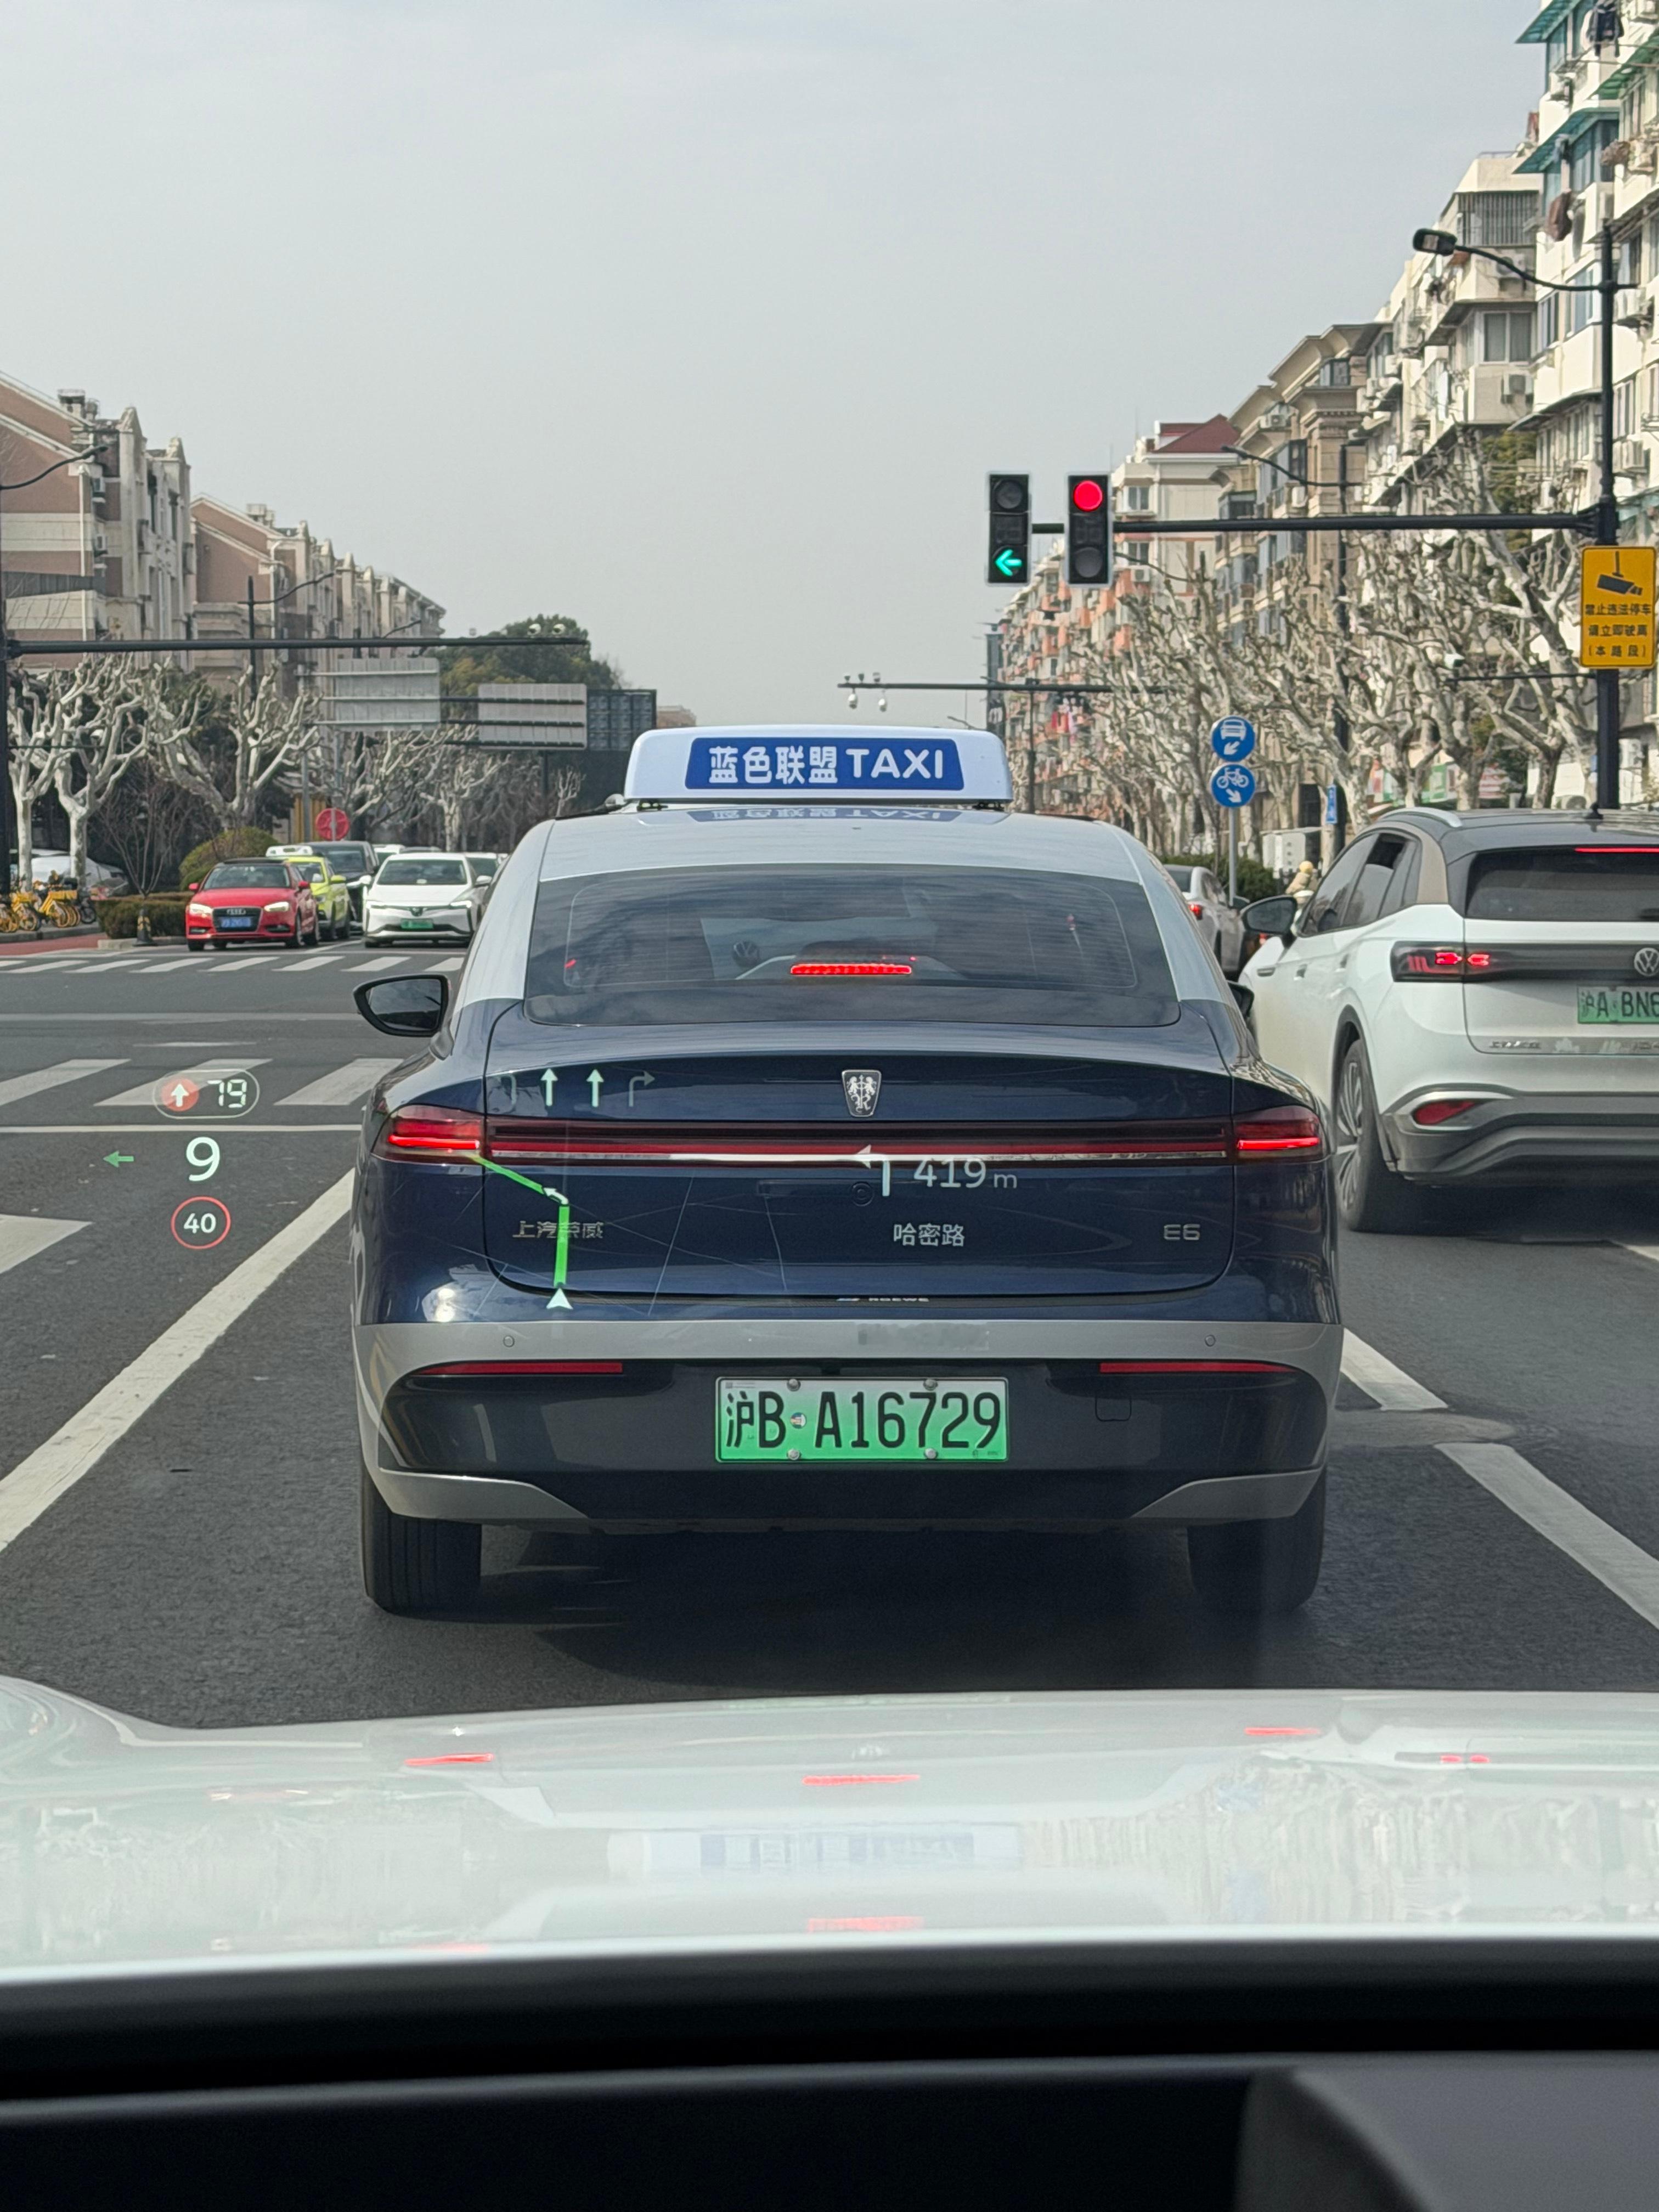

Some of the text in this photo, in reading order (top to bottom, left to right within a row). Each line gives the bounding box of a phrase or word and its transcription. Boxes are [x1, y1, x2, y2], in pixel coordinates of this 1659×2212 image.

[708, 746, 943, 785] 蓝色联盟 TAXI
[207, 1079, 247, 1108] 79
[186, 1137, 220, 1181] 9
[913, 1156, 1017, 1188] 419 m
[184, 1213, 216, 1234] 40
[893, 1222, 965, 1247] 哈密路
[1164, 1223, 1201, 1240] E6
